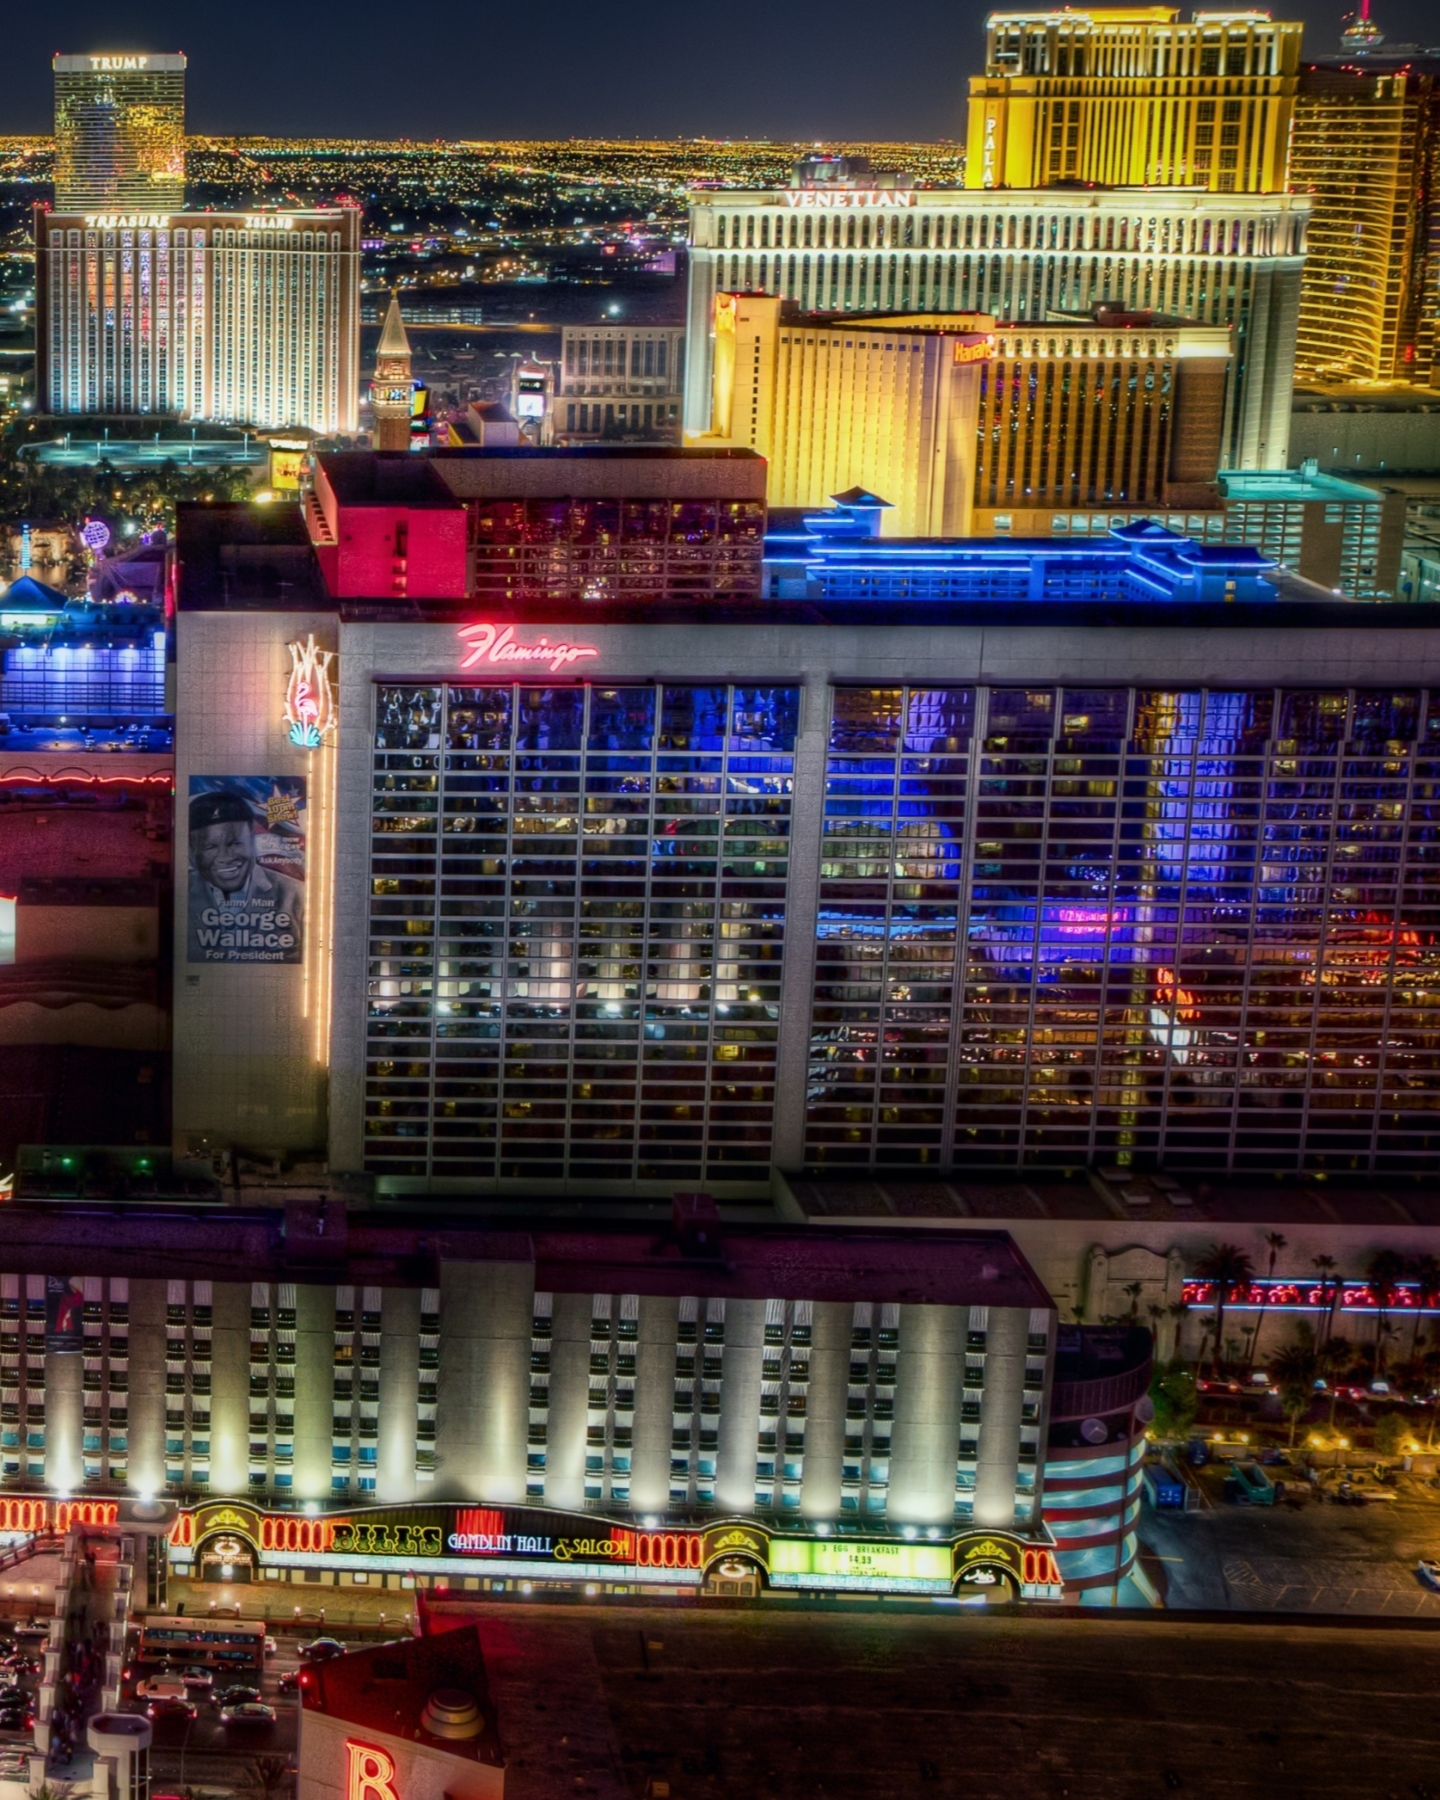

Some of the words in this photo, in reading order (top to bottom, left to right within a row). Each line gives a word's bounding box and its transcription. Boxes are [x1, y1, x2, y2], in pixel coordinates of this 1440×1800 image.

[90, 57, 147, 70] TRUMP
[983, 118, 996, 187] PALA
[784, 191, 912, 207] VENETIAN
[85, 215, 170, 228] TREASURE
[245, 216, 293, 229] ISLAND
[457, 623, 597, 671] Flamingo
[267, 794, 290, 805] Best
[267, 811, 298, 823] Show!
[217, 899, 248, 908] Funny
[251, 899, 275, 907] Man
[202, 909, 291, 931] George
[197, 929, 294, 948] Wallace
[206, 950, 225, 959] For
[228, 950, 284, 960] President
[331, 1524, 442, 1555] BILL'S
[517, 1536, 553, 1552] HALL
[554, 1539, 573, 1560] &
[571, 1538, 630, 1556] SALOON
[822, 1544, 827, 1552] 3
[833, 1545, 849, 1553] EGG
[857, 1546, 899, 1555] BREAKFAST
